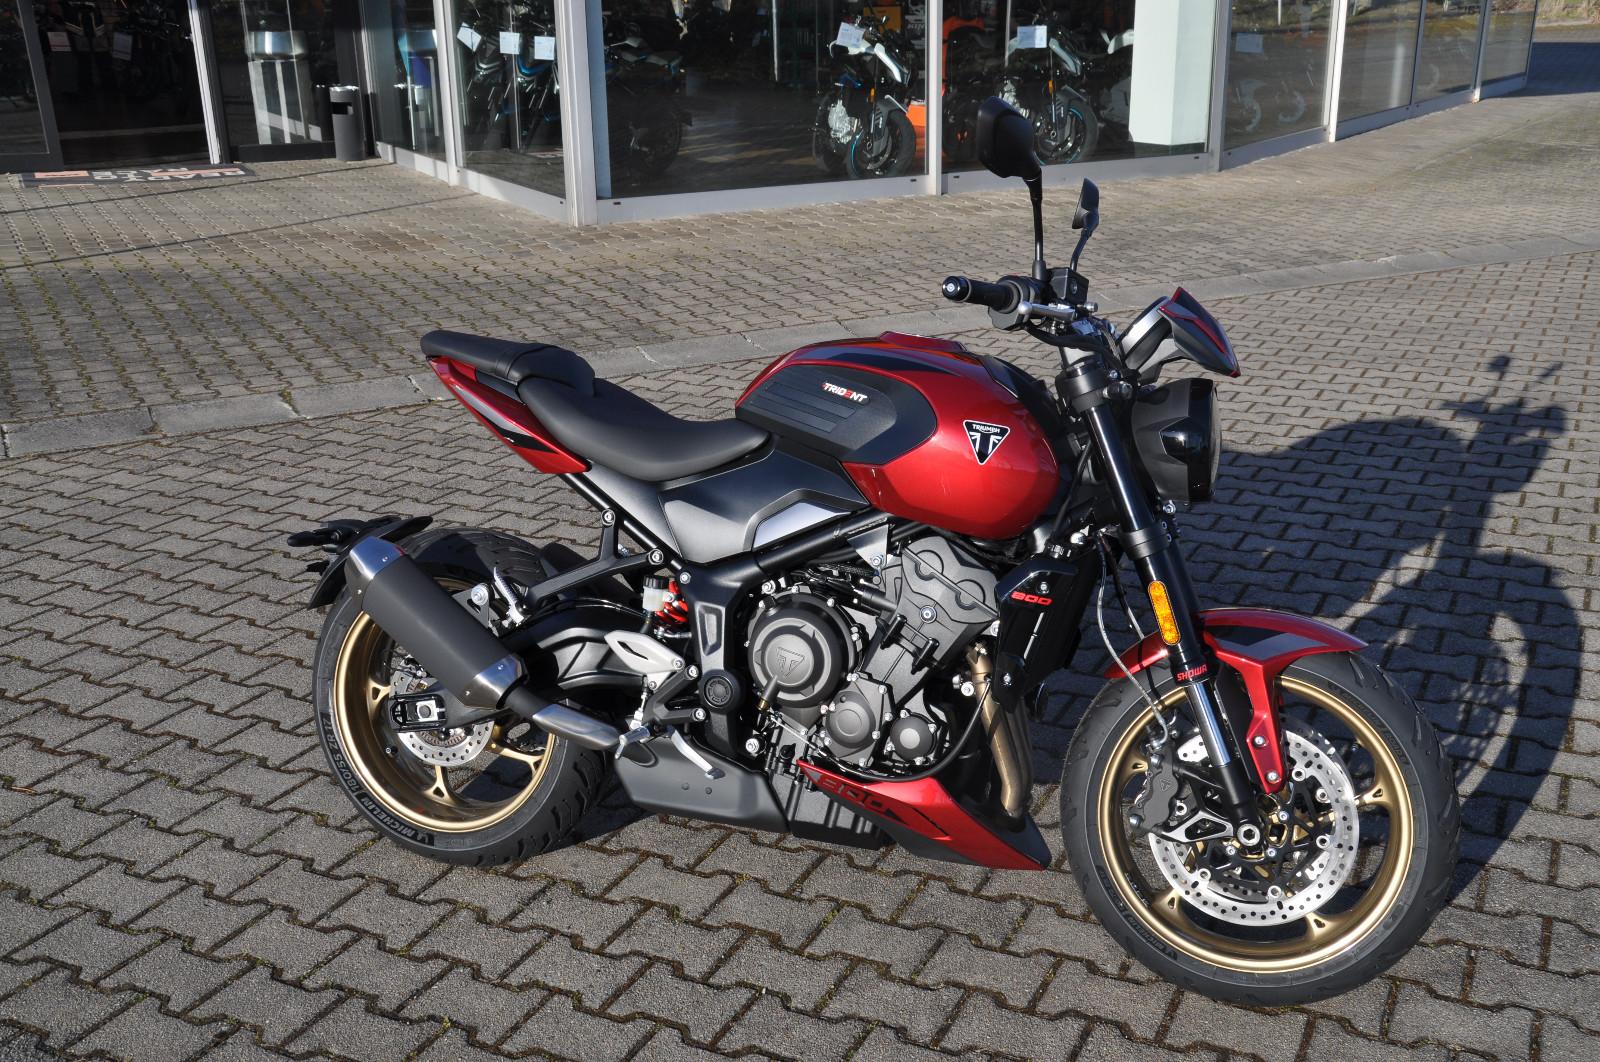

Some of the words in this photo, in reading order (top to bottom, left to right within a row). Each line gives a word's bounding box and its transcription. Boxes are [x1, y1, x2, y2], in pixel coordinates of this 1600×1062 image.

[823, 382, 868, 402] TRIDENT
[972, 423, 1001, 434] TRIUMPH
[1011, 591, 1053, 606] 800
[1177, 664, 1207, 681] SHOWA
[334, 752, 361, 793] 180/55
[360, 796, 416, 837] MICHELIN
